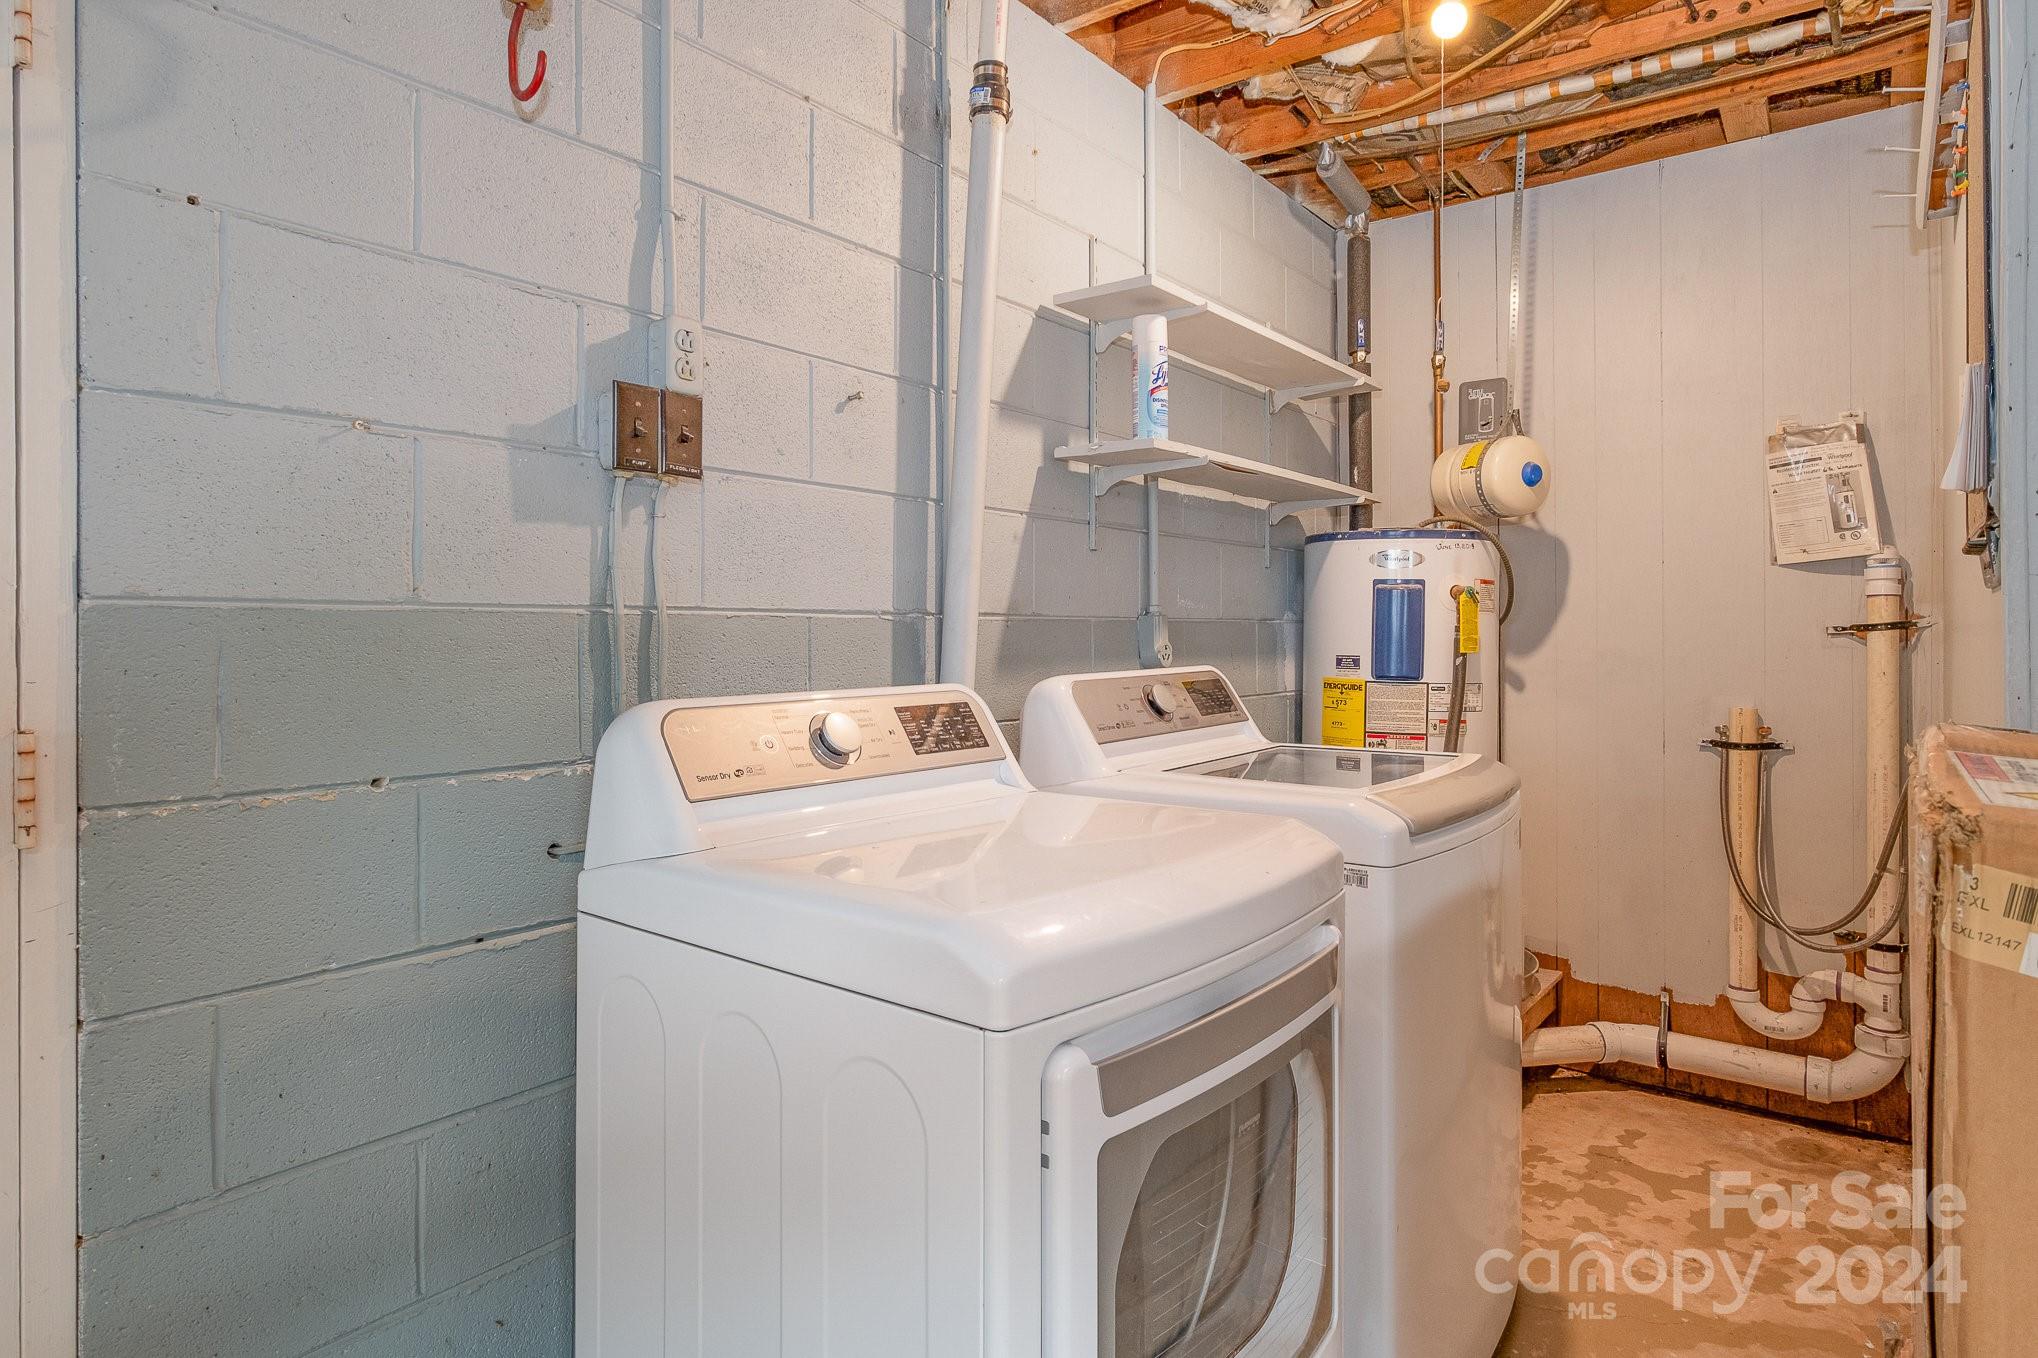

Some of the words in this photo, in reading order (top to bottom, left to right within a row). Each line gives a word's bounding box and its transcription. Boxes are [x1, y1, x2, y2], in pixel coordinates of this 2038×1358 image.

[696, 773, 719, 784] Sensor
[719, 772, 732, 781] Dry
[1969, 876, 1979, 891] 3
[1957, 891, 1990, 912] EXL
[1951, 920, 2023, 952] EXL12147
